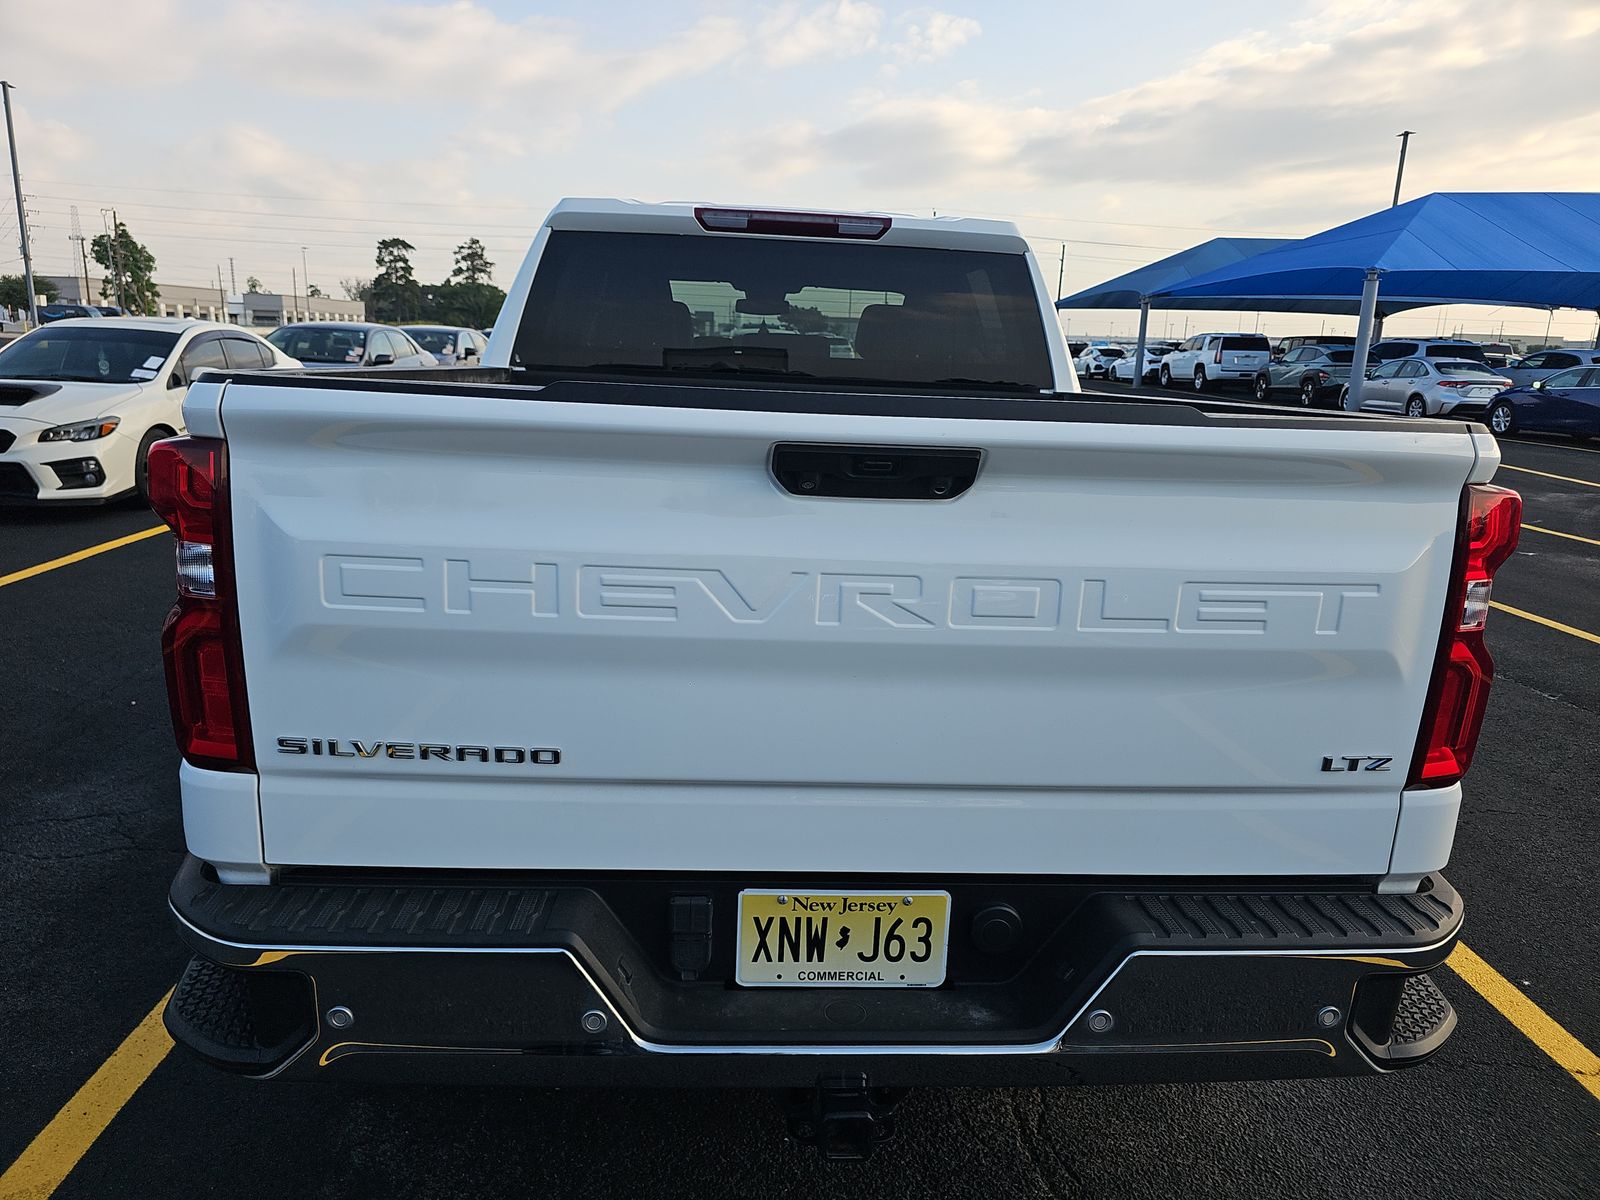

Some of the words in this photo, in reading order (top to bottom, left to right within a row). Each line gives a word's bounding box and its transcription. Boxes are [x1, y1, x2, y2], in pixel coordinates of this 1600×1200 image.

[318, 553, 1382, 636] CHEVROLET
[277, 736, 562, 765] SILVERADO
[1320, 755, 1393, 772] LTZ
[791, 897, 837, 912] New
[838, 897, 898, 916] Jersey
[751, 916, 829, 963] XNW
[857, 916, 933, 963] J63
[797, 971, 885, 982] COMMERCIAL
